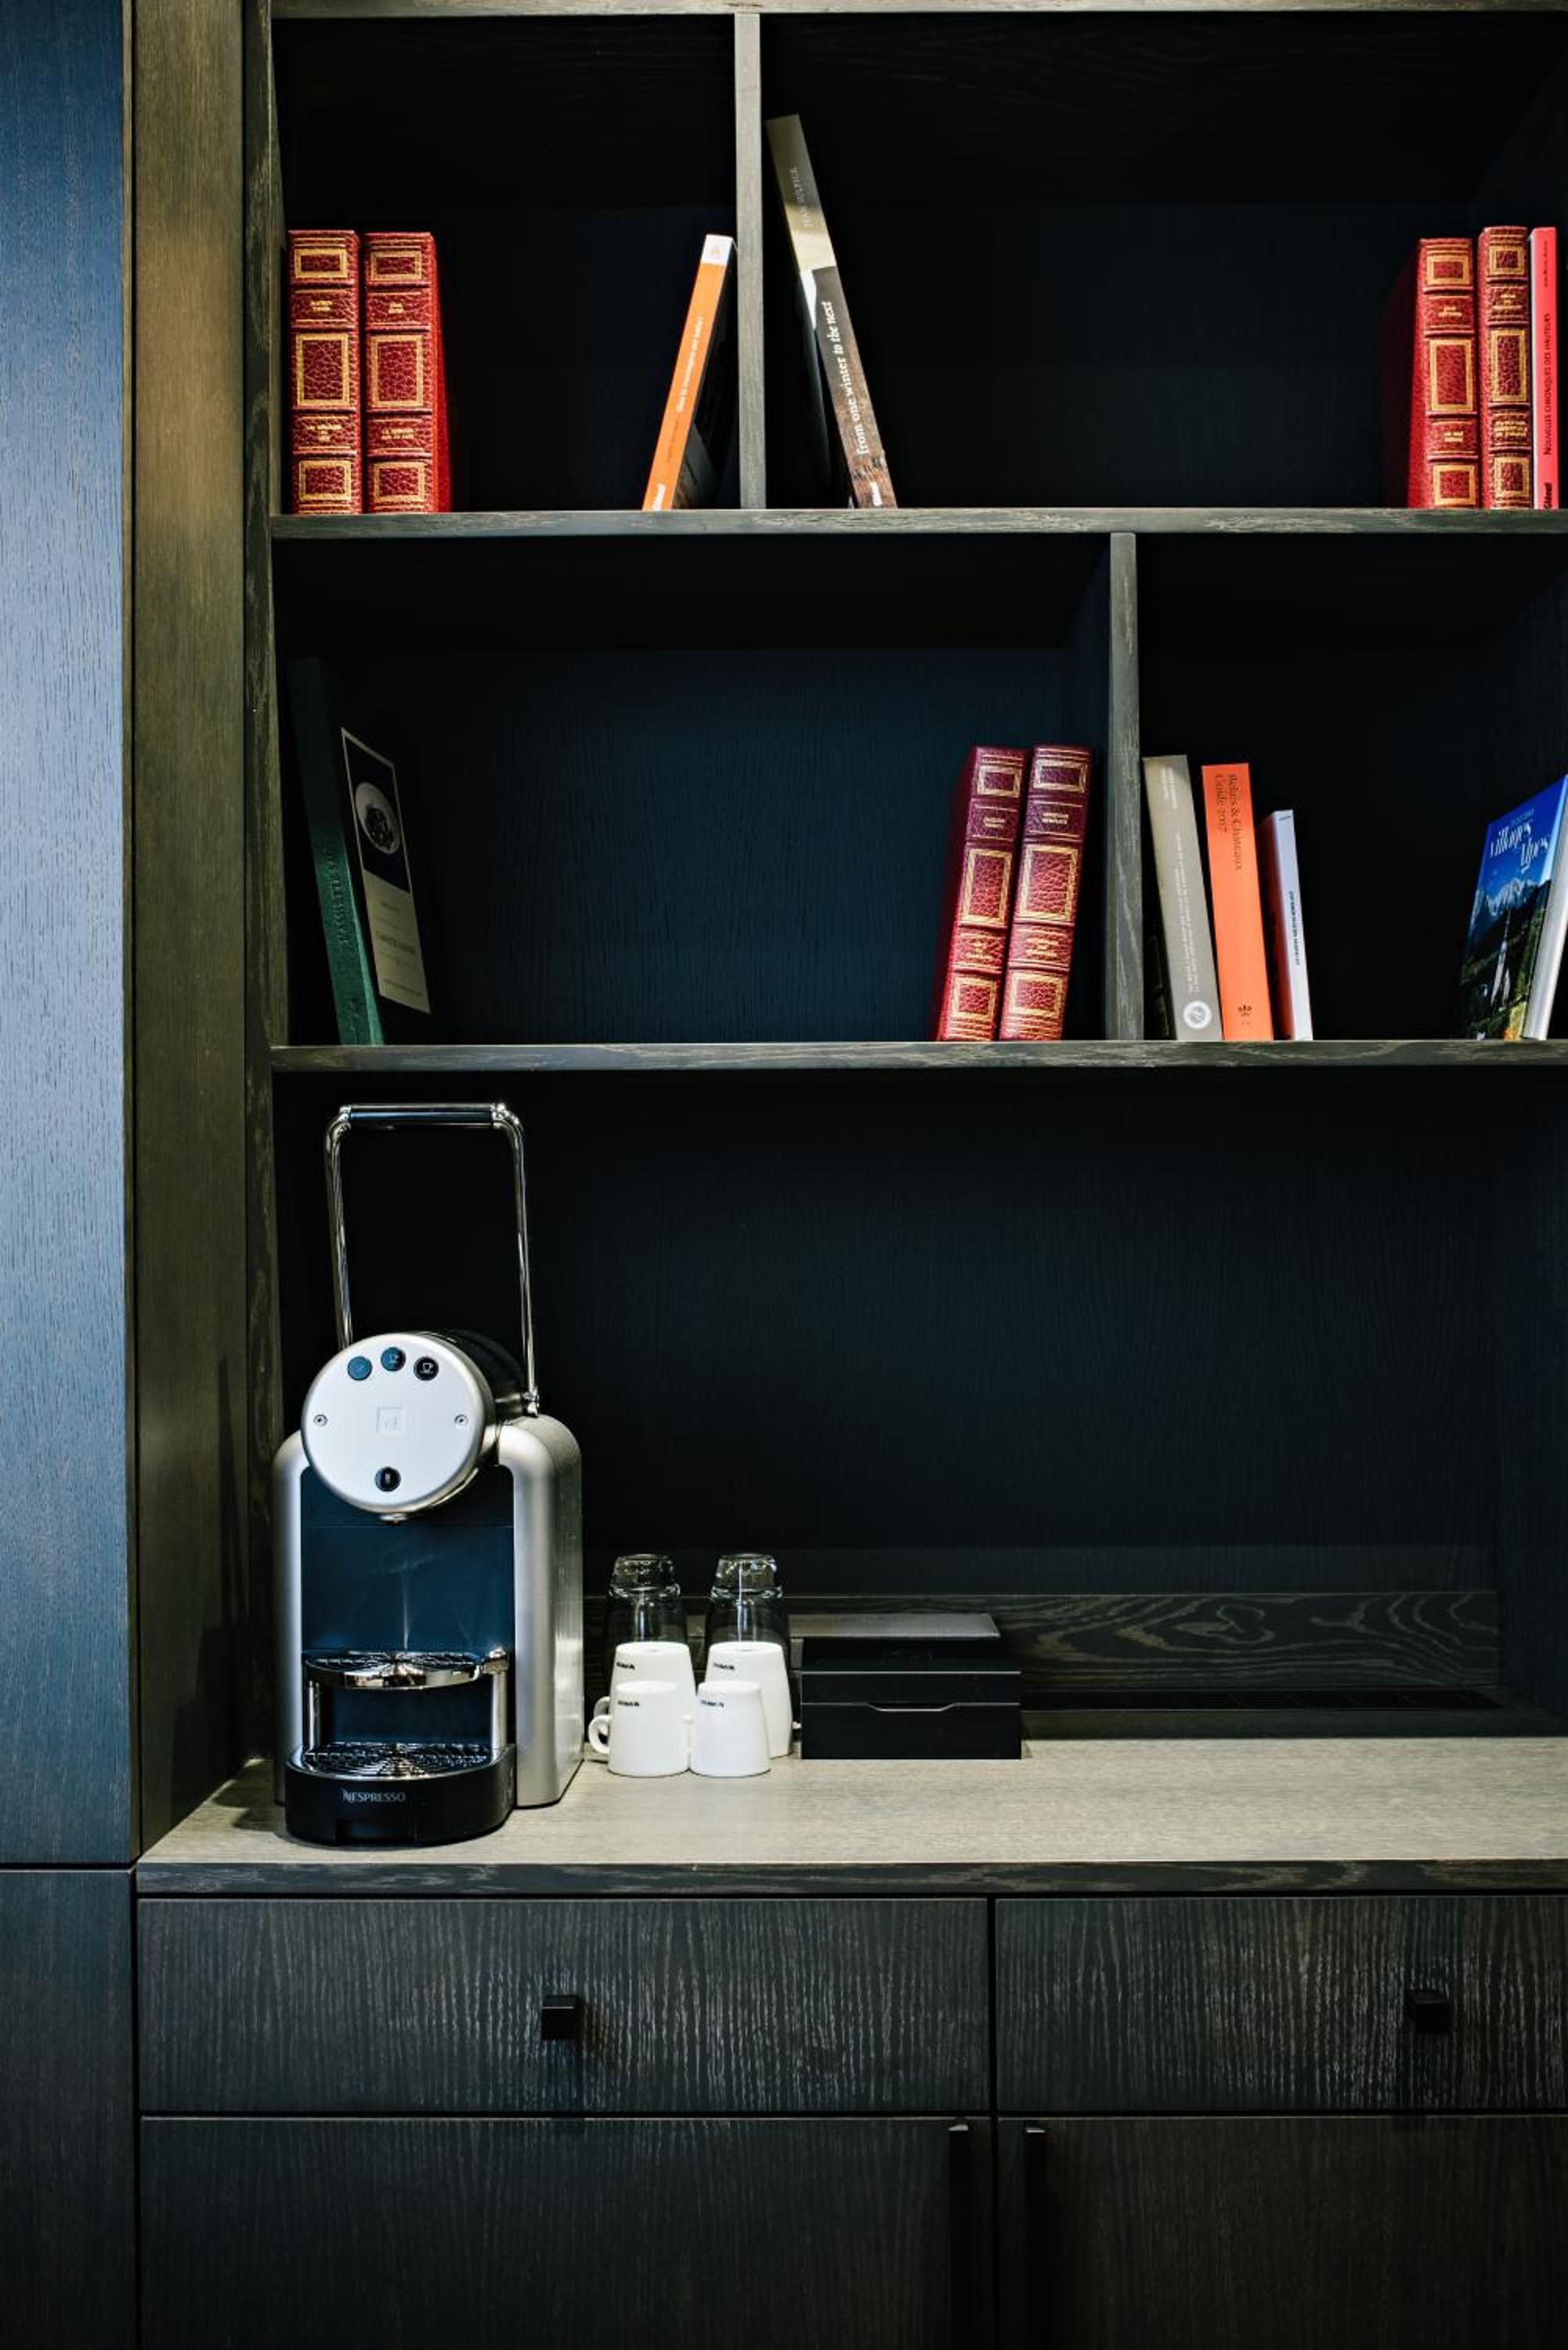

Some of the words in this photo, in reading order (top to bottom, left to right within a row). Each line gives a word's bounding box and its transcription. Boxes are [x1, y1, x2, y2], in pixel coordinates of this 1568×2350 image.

[822, 301, 836, 325] next
[826, 325, 840, 342] the
[833, 344, 844, 355] to
[837, 356, 854, 397] winter
[848, 396, 860, 422] one
[854, 423, 869, 455] from
[1230, 807, 1240, 819] &
[341, 1788, 407, 1804] NESPRESSO
